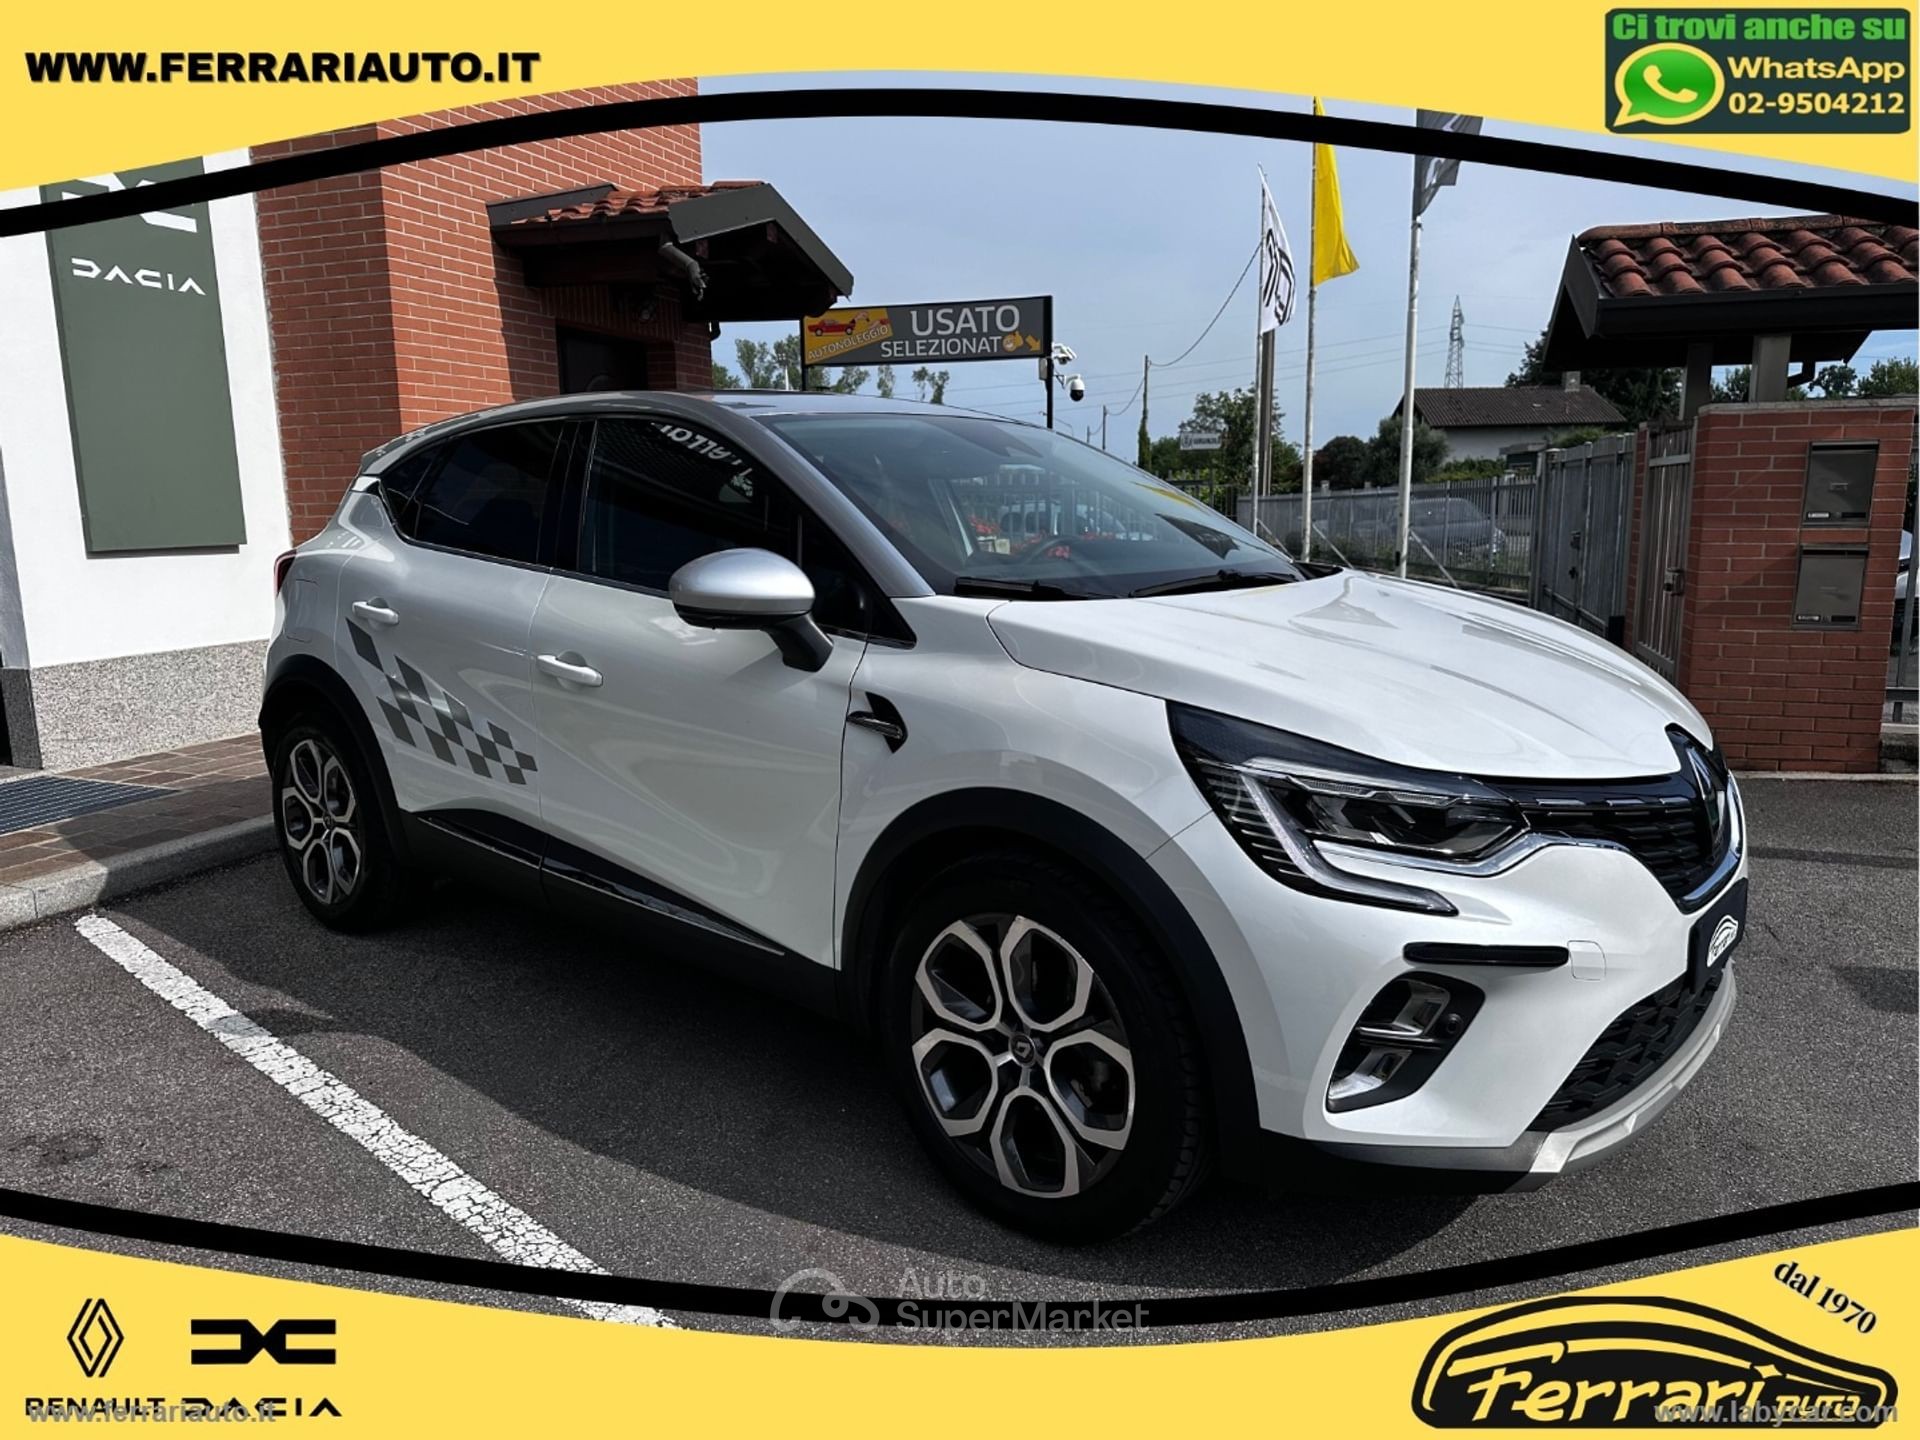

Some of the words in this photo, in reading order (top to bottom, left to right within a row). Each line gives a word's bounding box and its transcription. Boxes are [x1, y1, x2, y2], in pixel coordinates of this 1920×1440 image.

[71, 257, 206, 296] DACIA
[910, 304, 1020, 336] USATO
[808, 325, 890, 361] AUTONOLEGGIO
[880, 335, 1013, 358] SELEZIONAT
